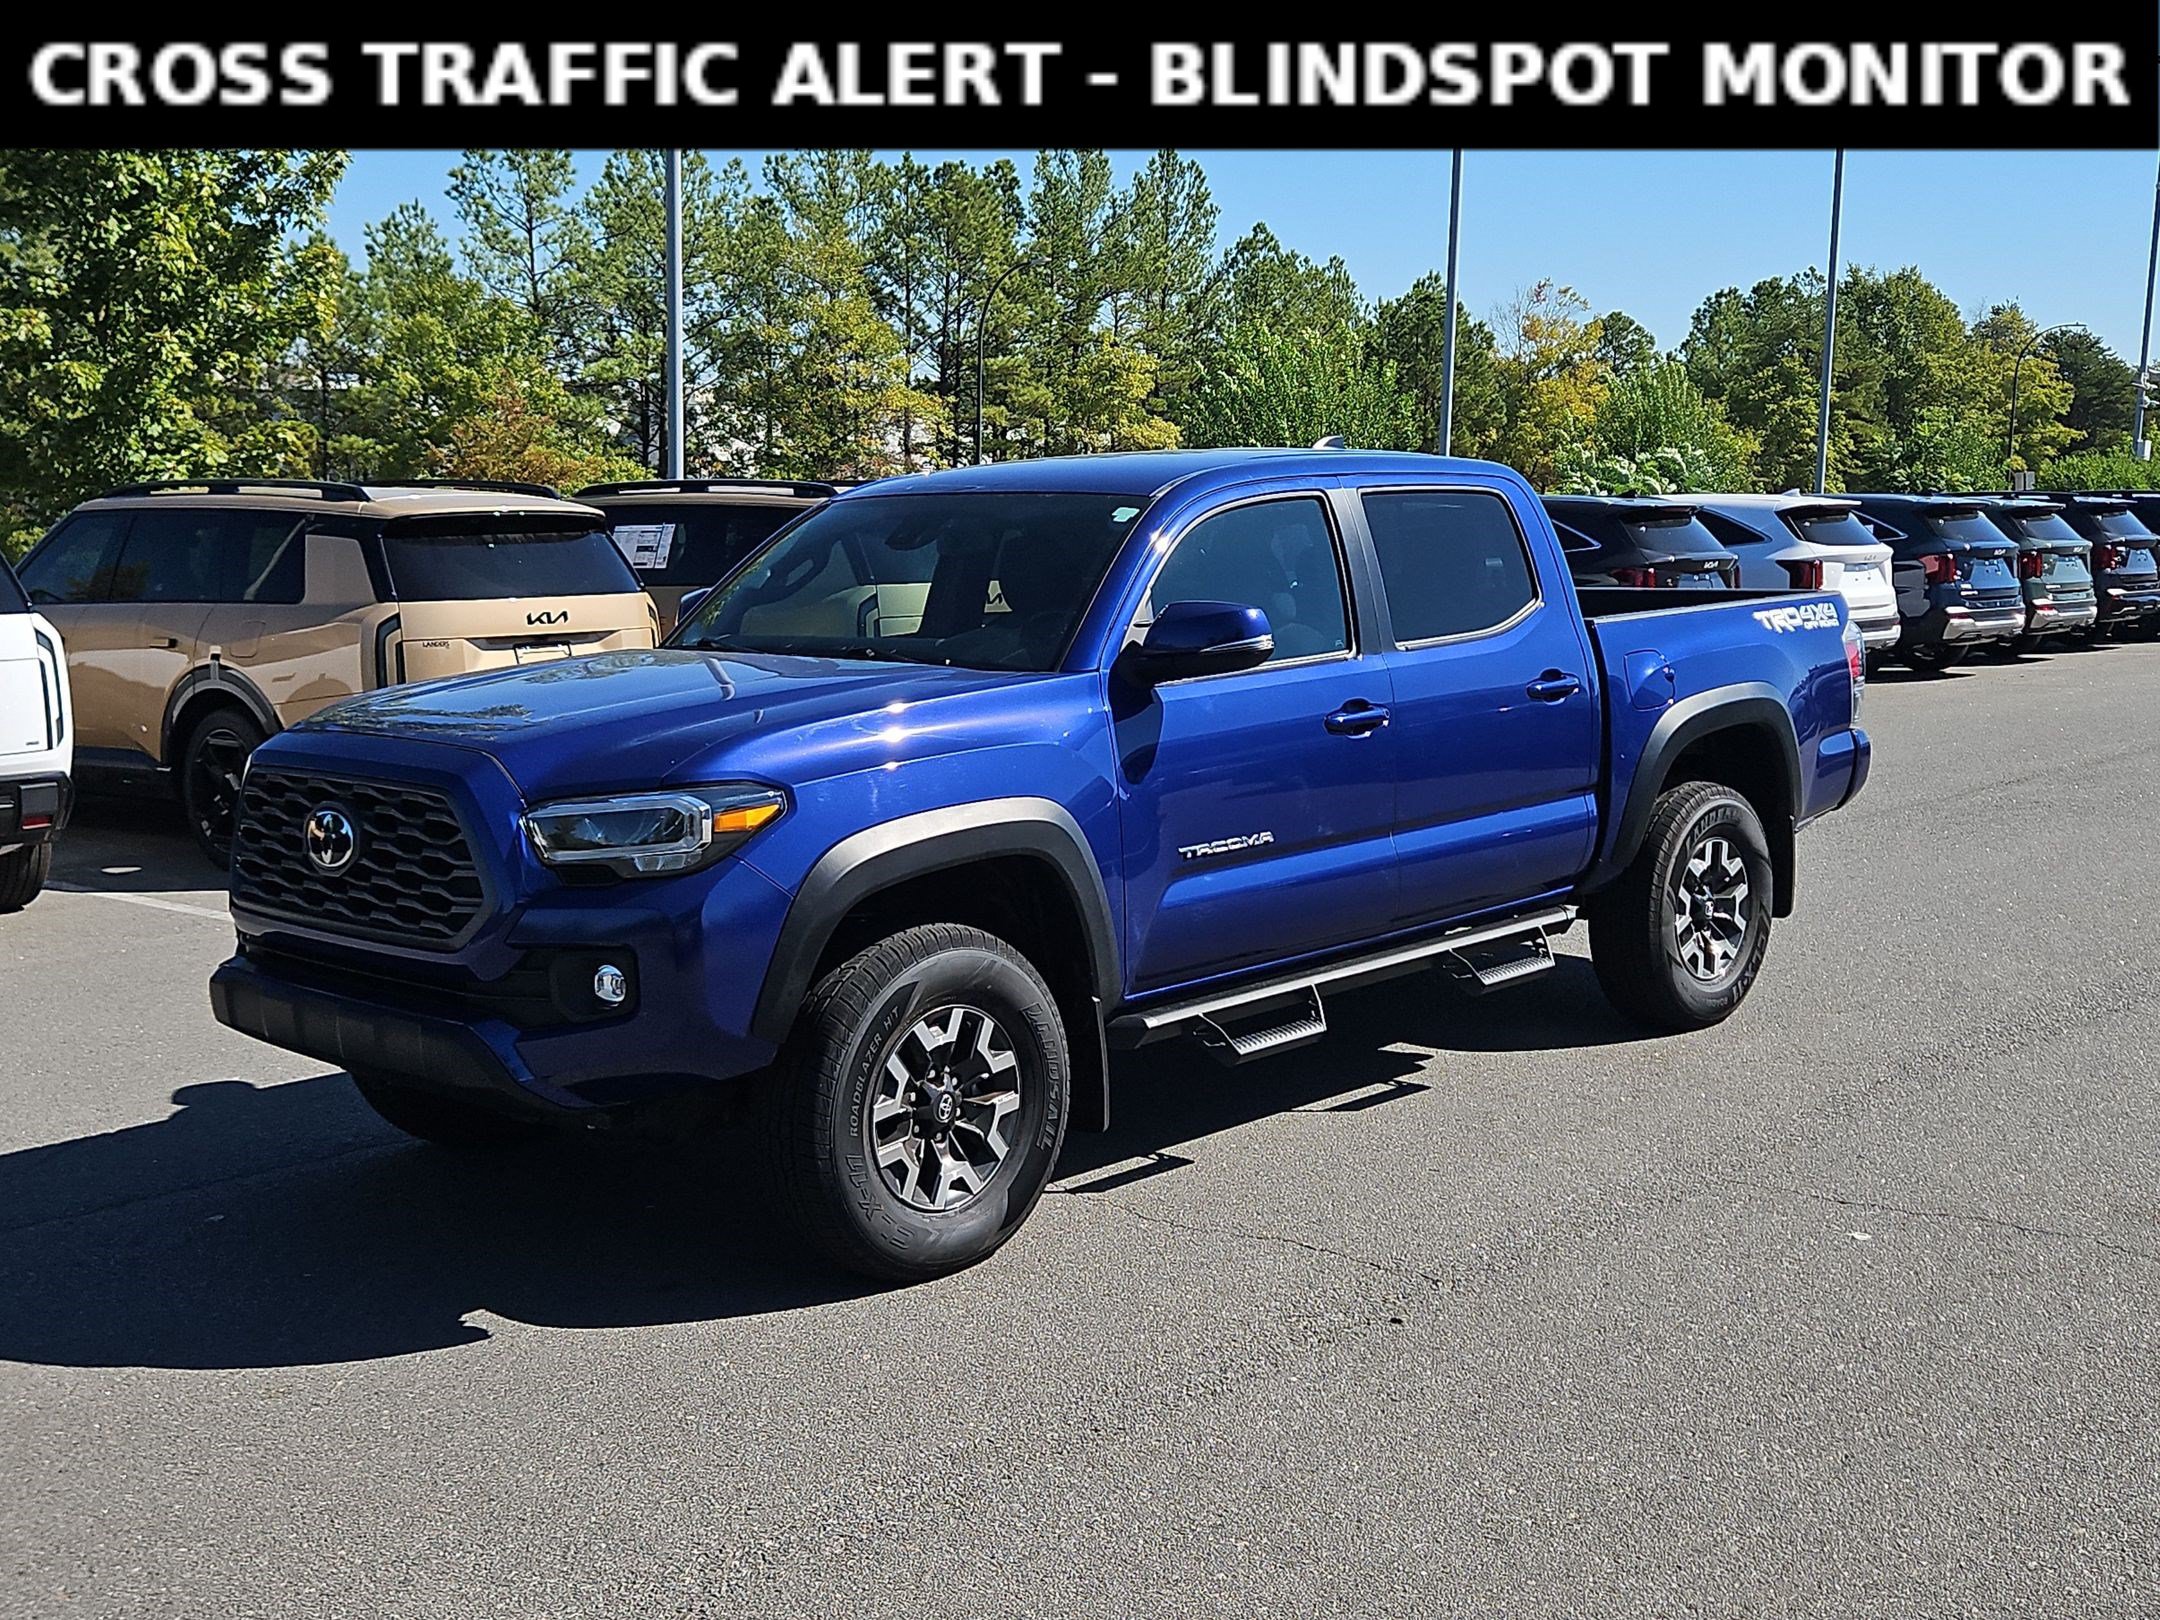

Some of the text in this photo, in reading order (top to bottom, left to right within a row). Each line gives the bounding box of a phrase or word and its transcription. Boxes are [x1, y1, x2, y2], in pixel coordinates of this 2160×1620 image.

[526, 610, 569, 626] KIA
[1752, 606, 1803, 634] TRD
[1178, 831, 1275, 858] TACOMA
[849, 1032, 883, 1137] ROADBLAZER
[1019, 1002, 1061, 1152] LANDSAIL
